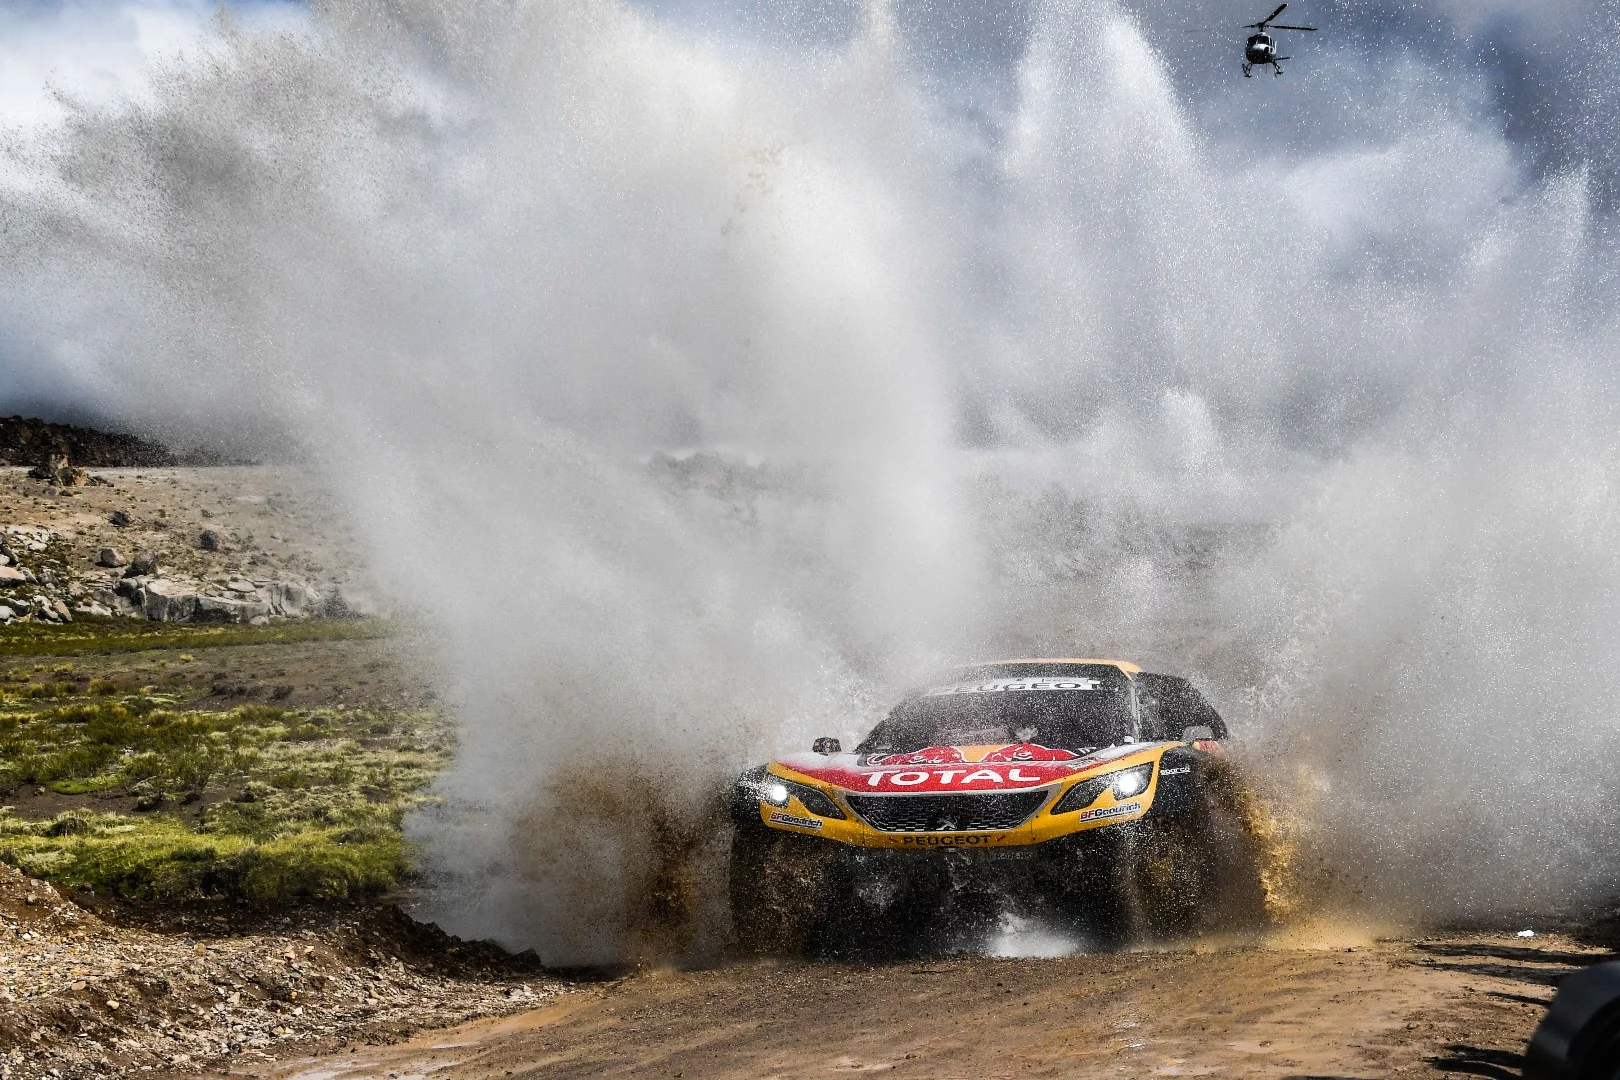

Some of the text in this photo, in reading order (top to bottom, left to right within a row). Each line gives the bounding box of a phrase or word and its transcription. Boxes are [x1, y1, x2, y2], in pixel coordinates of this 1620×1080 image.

[861, 768, 1041, 787] TOTAL
[770, 812, 823, 827] BFGoodrich
[902, 835, 992, 846] PEUGEOT
